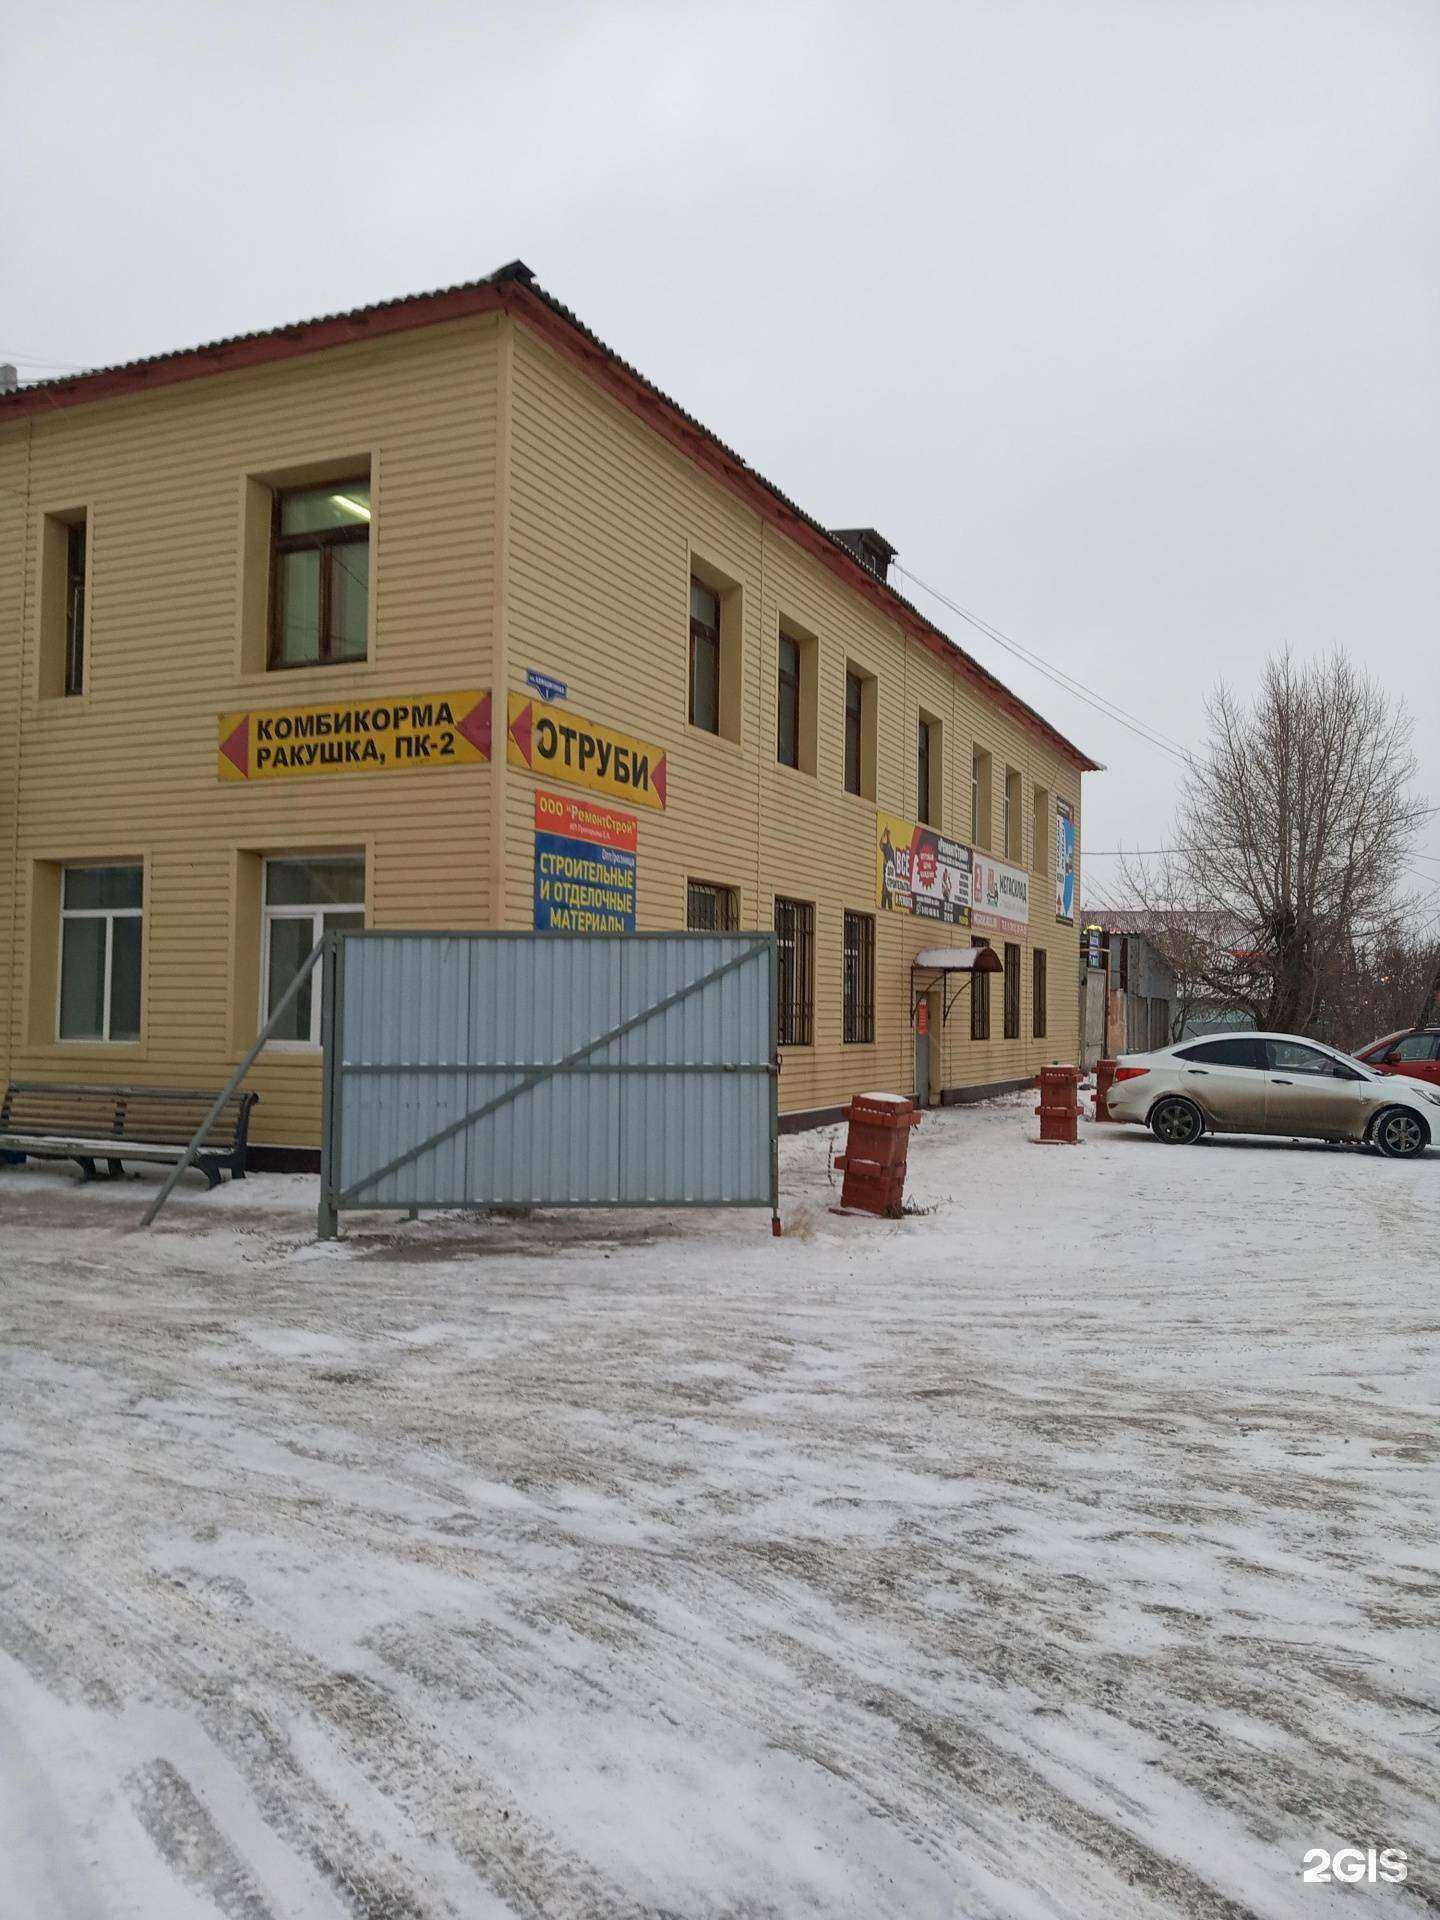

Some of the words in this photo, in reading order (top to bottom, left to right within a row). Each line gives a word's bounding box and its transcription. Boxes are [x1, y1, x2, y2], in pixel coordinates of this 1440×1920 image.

[257, 702, 454, 741] КОМБИКОРМА
[256, 739, 386, 769] РАКУШКА,
[395, 732, 455, 759] ПК-2
[537, 718, 650, 793] ОТРУБИ
[540, 796, 563, 816] ООО
[540, 852, 634, 888] СТРОИТЕЛЬНЫЕ
[540, 879, 550, 900] И
[553, 880, 633, 913] ОТДЕЛОЧНЫЕ
[550, 906, 625, 932] МАТЕРИАЛЫ
